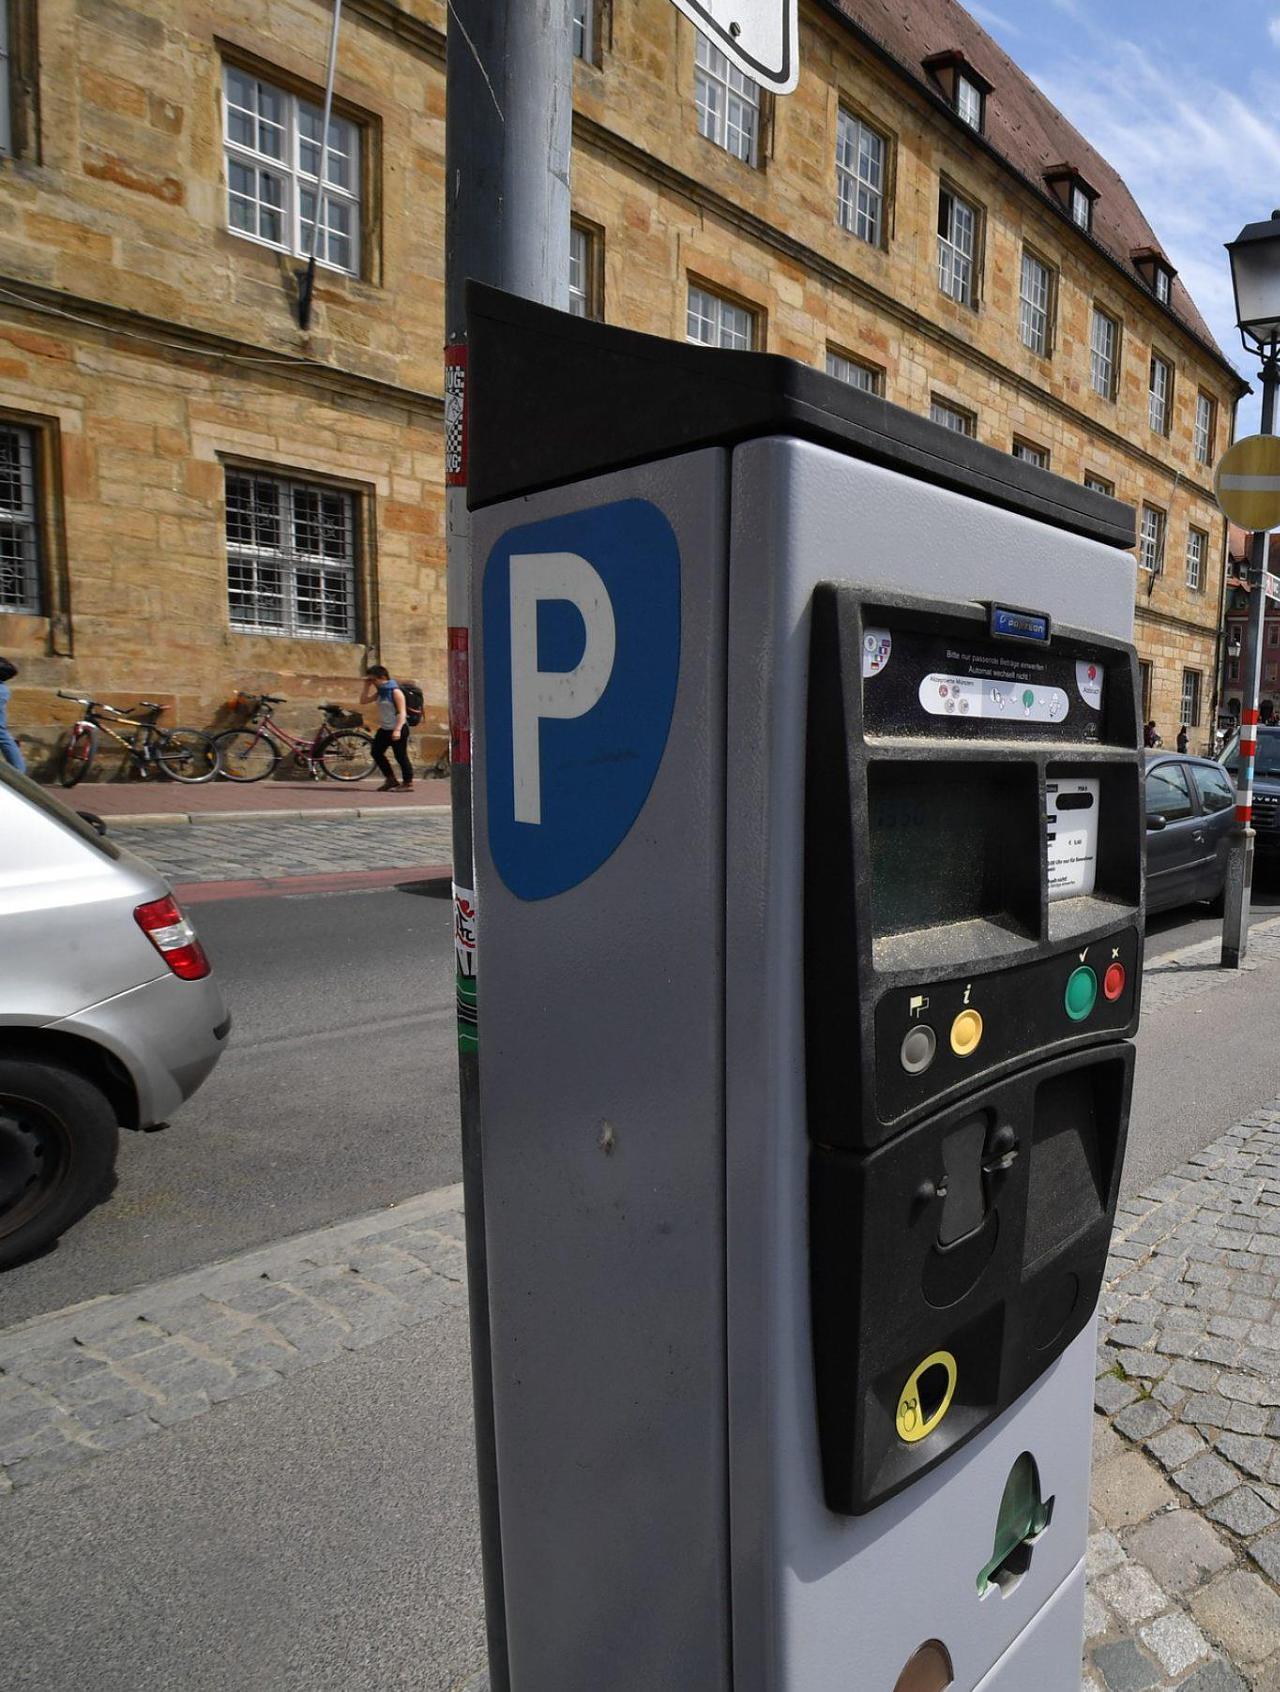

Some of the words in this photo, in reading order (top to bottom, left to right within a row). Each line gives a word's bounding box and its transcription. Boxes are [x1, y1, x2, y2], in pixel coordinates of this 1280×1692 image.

[946, 649, 960, 659] Bitte
[968, 665, 992, 675] Automat
[509, 552, 616, 825] P
